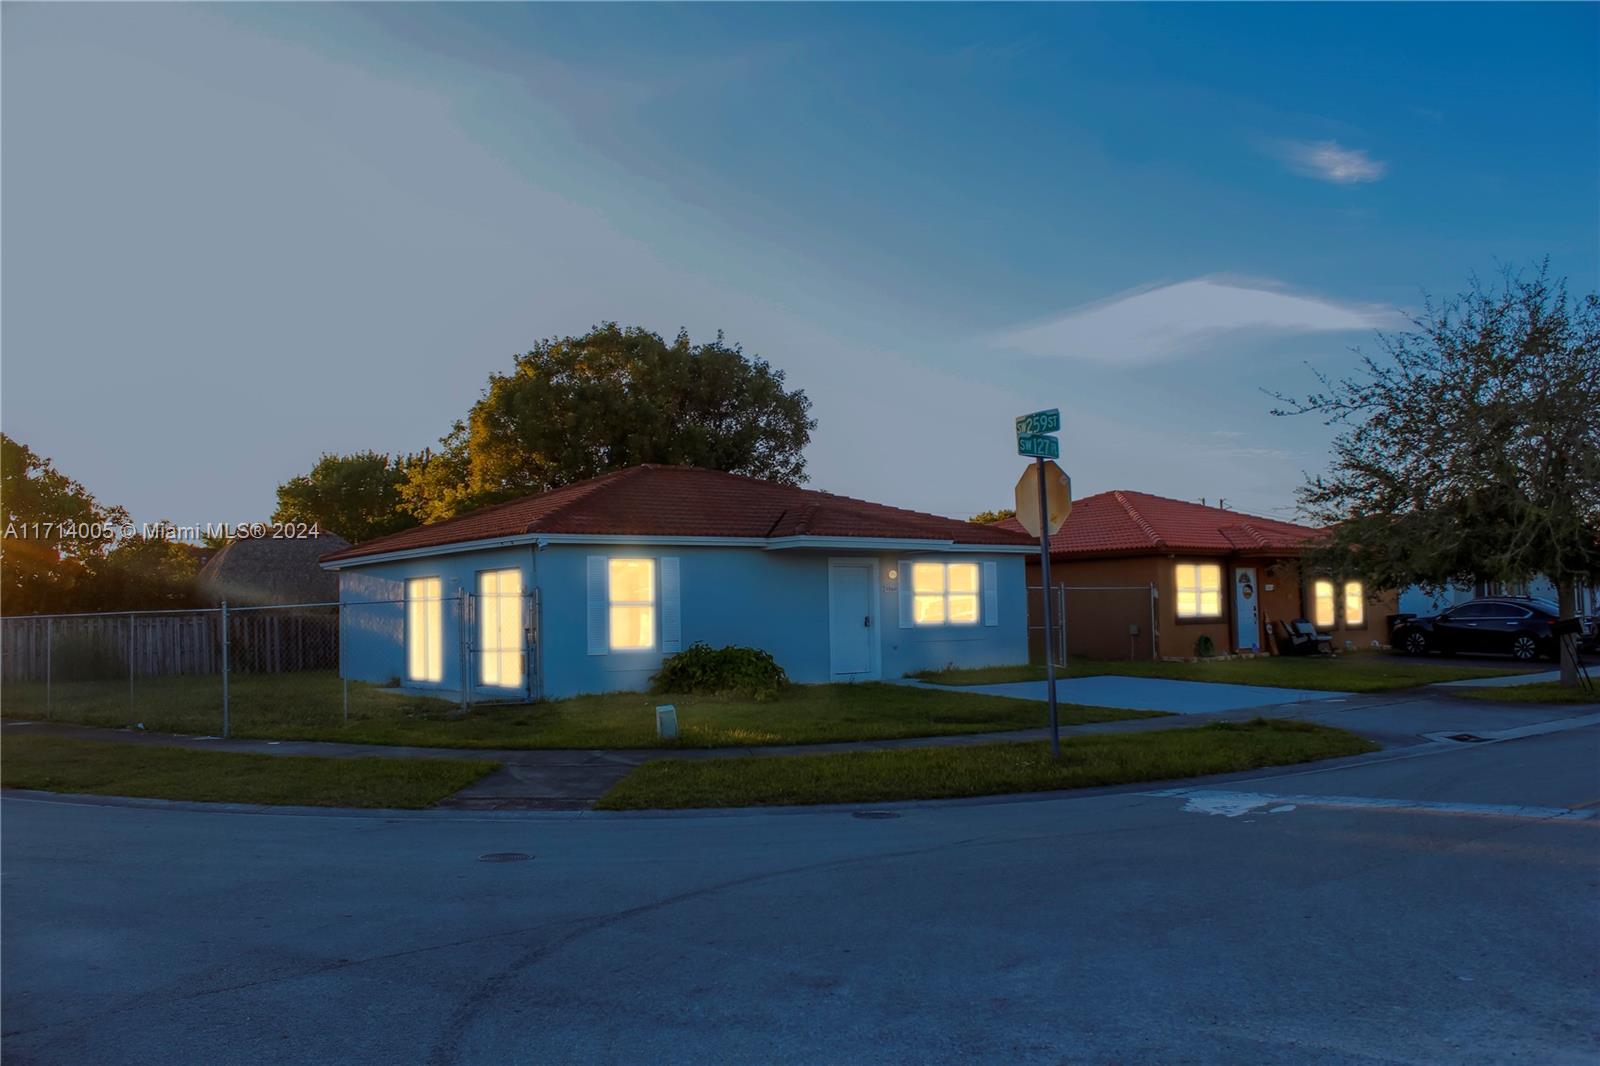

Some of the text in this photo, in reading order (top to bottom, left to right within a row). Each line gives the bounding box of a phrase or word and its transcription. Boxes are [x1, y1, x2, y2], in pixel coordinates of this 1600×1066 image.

[1017, 415, 1057, 433] SW 259 ST
[1020, 439, 1032, 451] SW
[1033, 438, 1049, 454] 127
